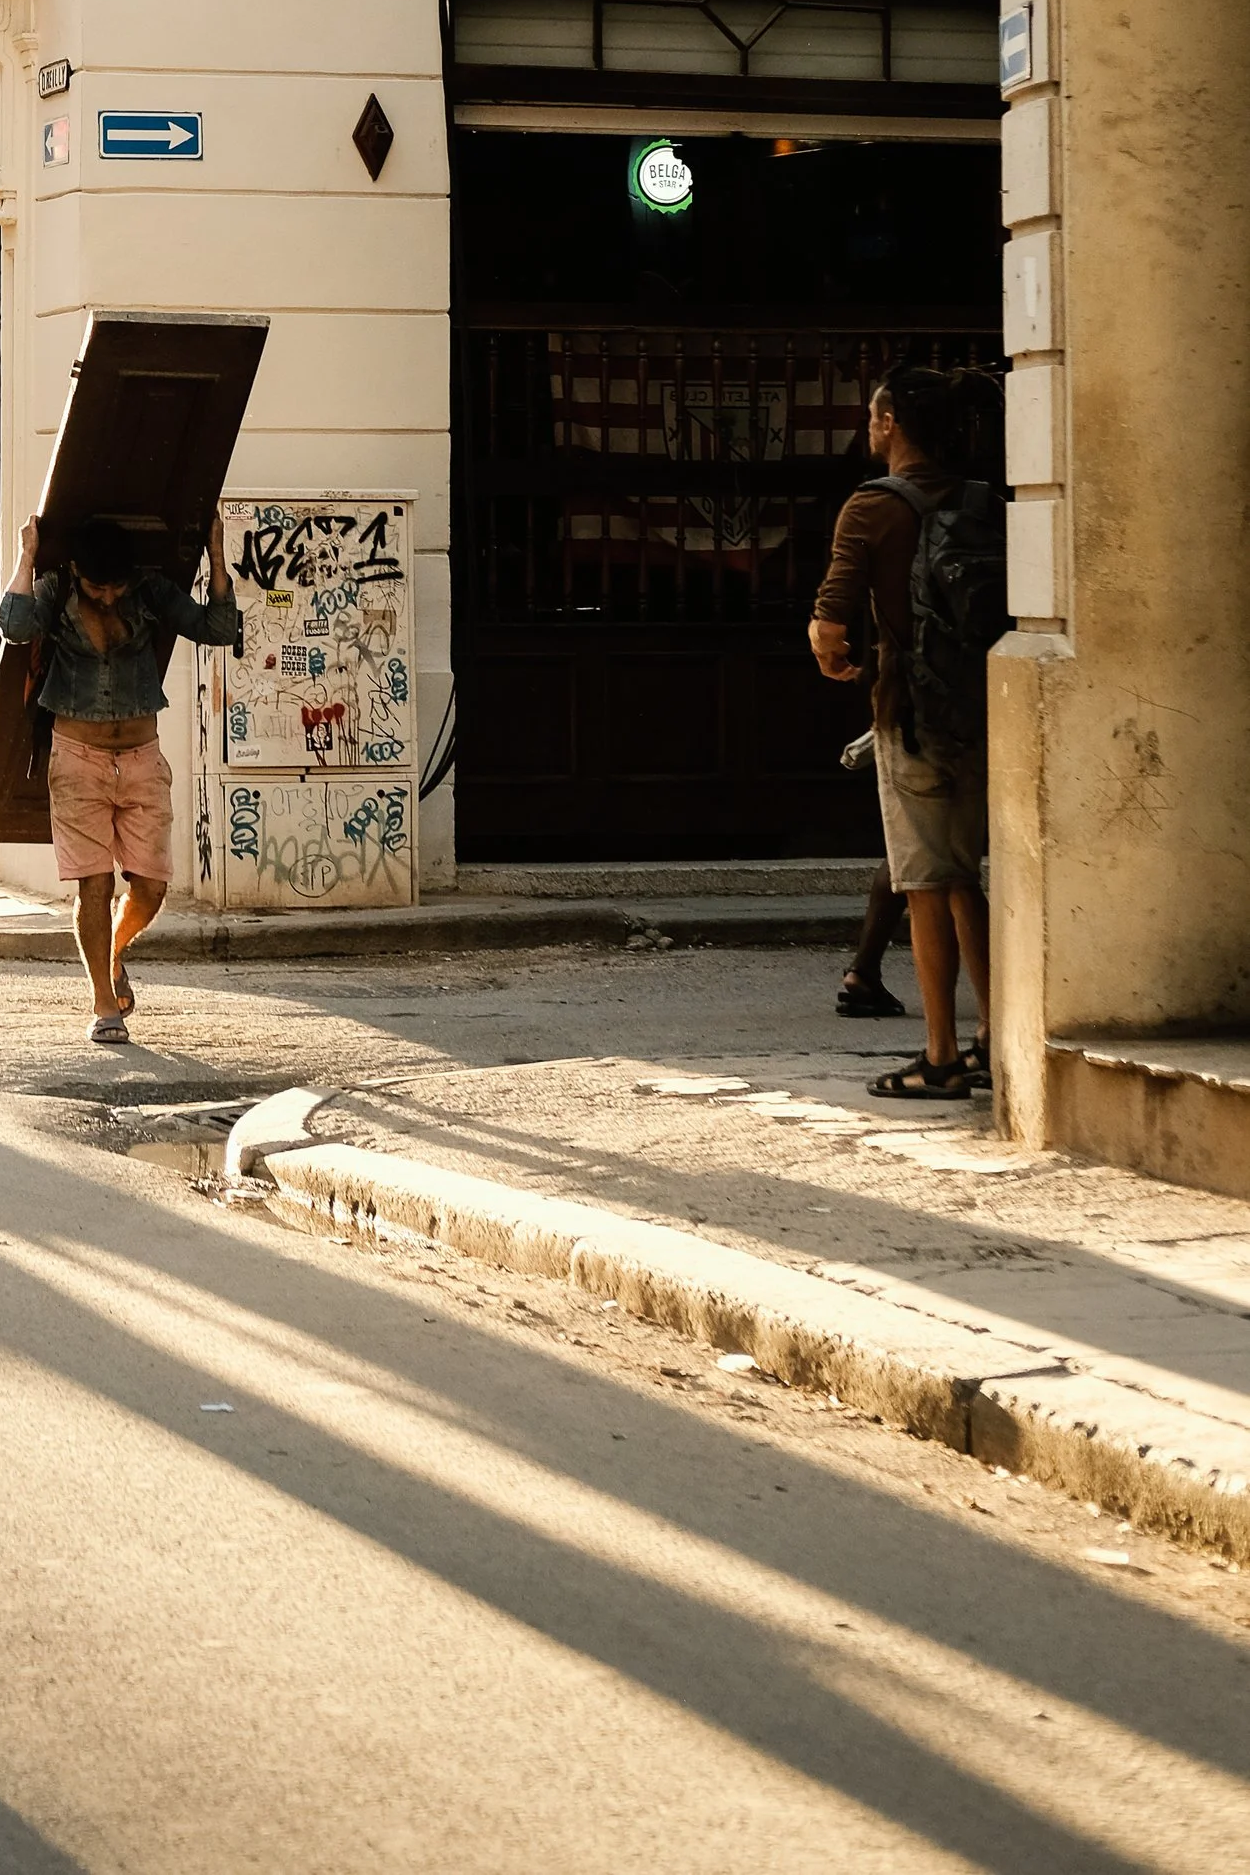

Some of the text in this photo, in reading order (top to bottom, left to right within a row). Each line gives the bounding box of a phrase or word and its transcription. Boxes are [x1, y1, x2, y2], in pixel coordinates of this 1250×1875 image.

[649, 163, 686, 181] BELGA
[658, 179, 677, 188] STAR
[281, 644, 307, 657] DOZER
[281, 660, 307, 671] DOZER
